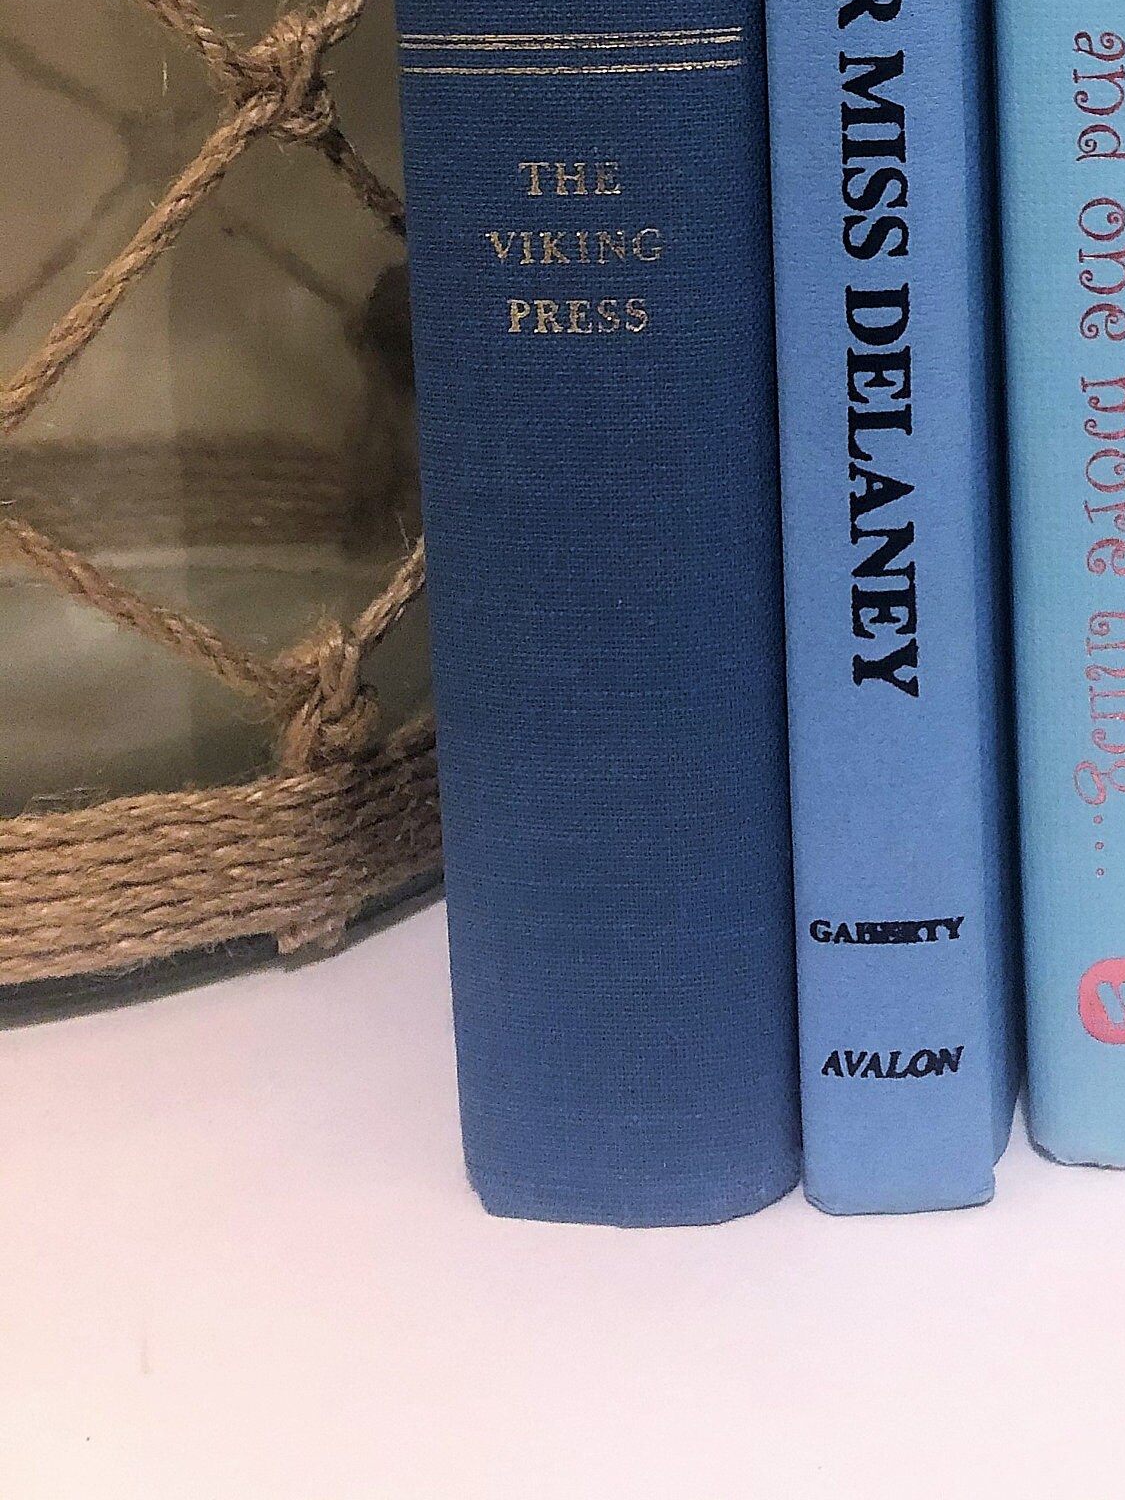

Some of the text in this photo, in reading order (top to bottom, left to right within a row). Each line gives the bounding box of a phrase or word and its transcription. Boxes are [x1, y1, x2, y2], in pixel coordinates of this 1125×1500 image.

[838, 49, 910, 261] MISS
[517, 161, 622, 196] THE
[485, 227, 663, 265] VIKING
[507, 298, 649, 334] PRESS
[844, 282, 920, 698] DELANEY
[820, 1045, 965, 1079] AVALON
